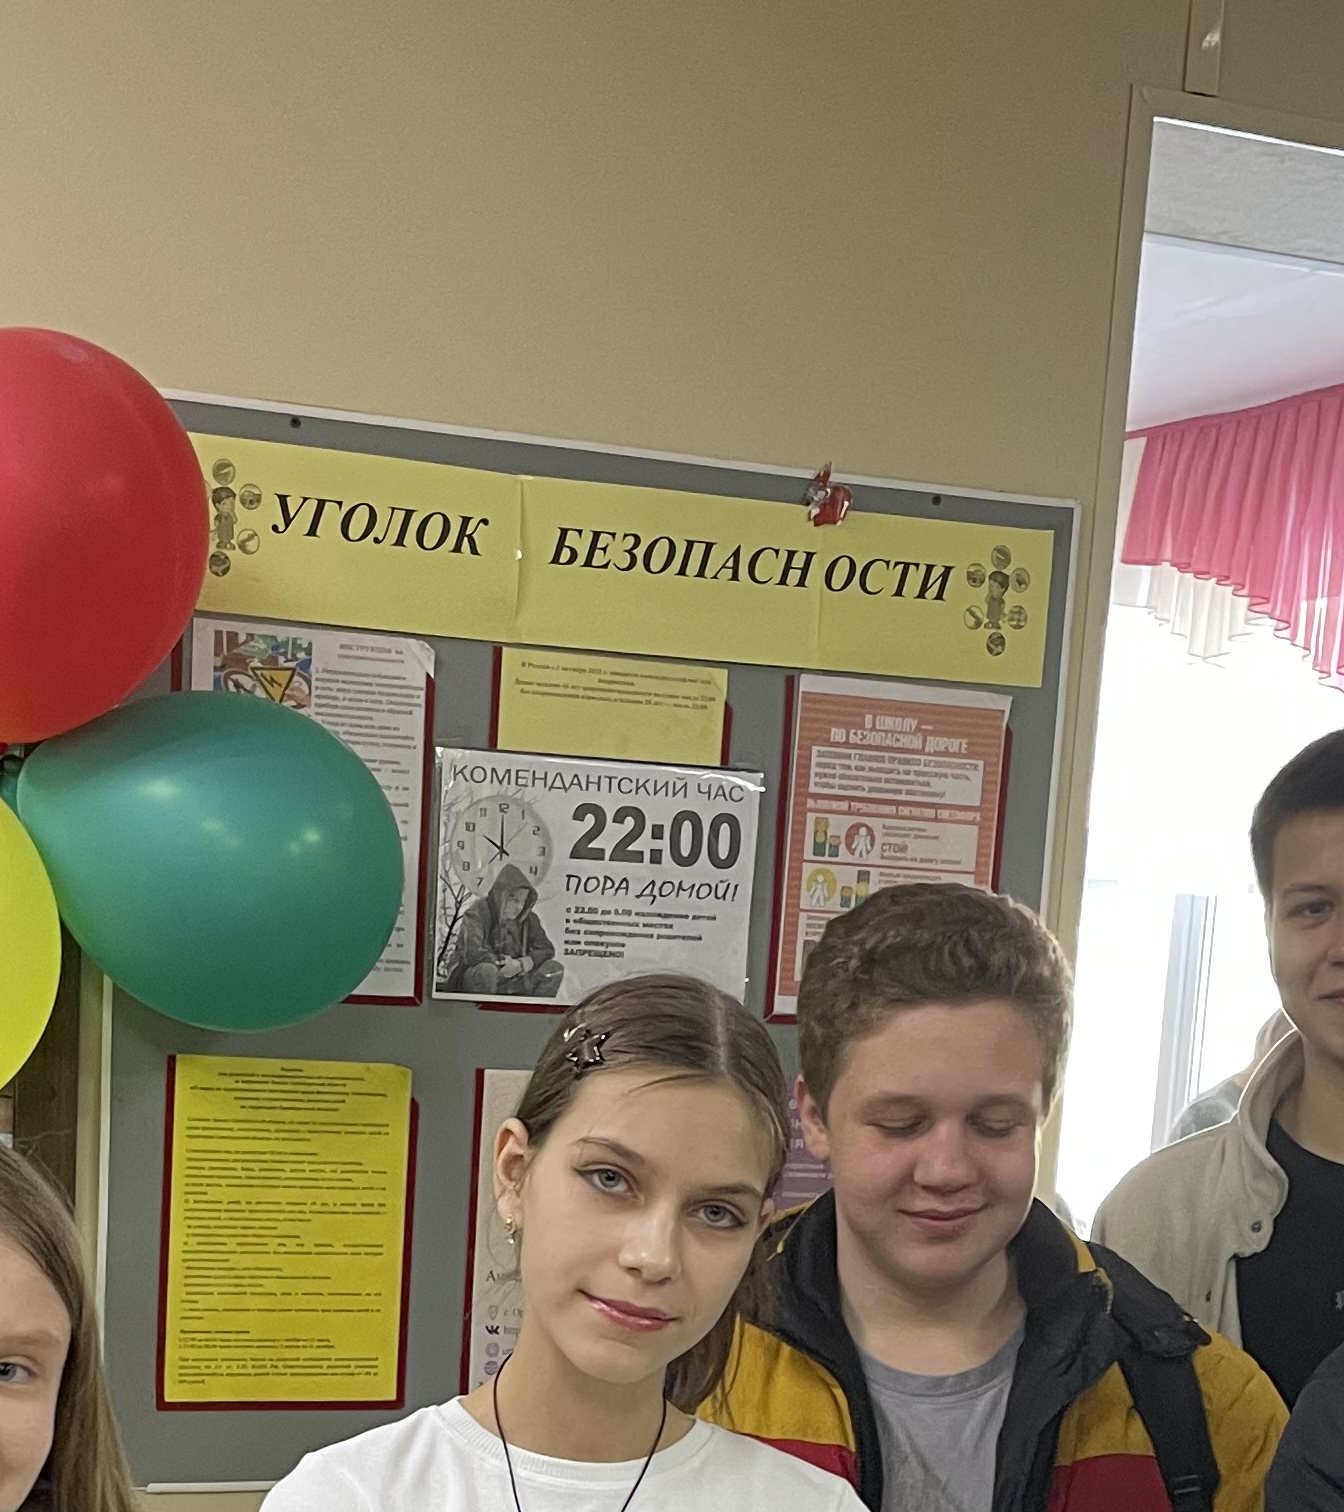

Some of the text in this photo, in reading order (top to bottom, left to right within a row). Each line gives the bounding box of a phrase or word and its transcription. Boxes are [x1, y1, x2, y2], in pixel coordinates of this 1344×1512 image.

[272, 493, 955, 601] УГОЛОК БЕЗОПАСНОСТИ
[865, 714, 873, 729] В
[875, 715, 919, 732] ШКОЛУ
[830, 727, 968, 754] ПО БЕЗОПАСНОЙ ДОРОГЕ
[453, 764, 745, 802] КОМЕНДАНТСКИЙ ЧАС
[568, 803, 741, 869] 22:00
[565, 874, 739, 905] ПОРА ДОМОЙ!
